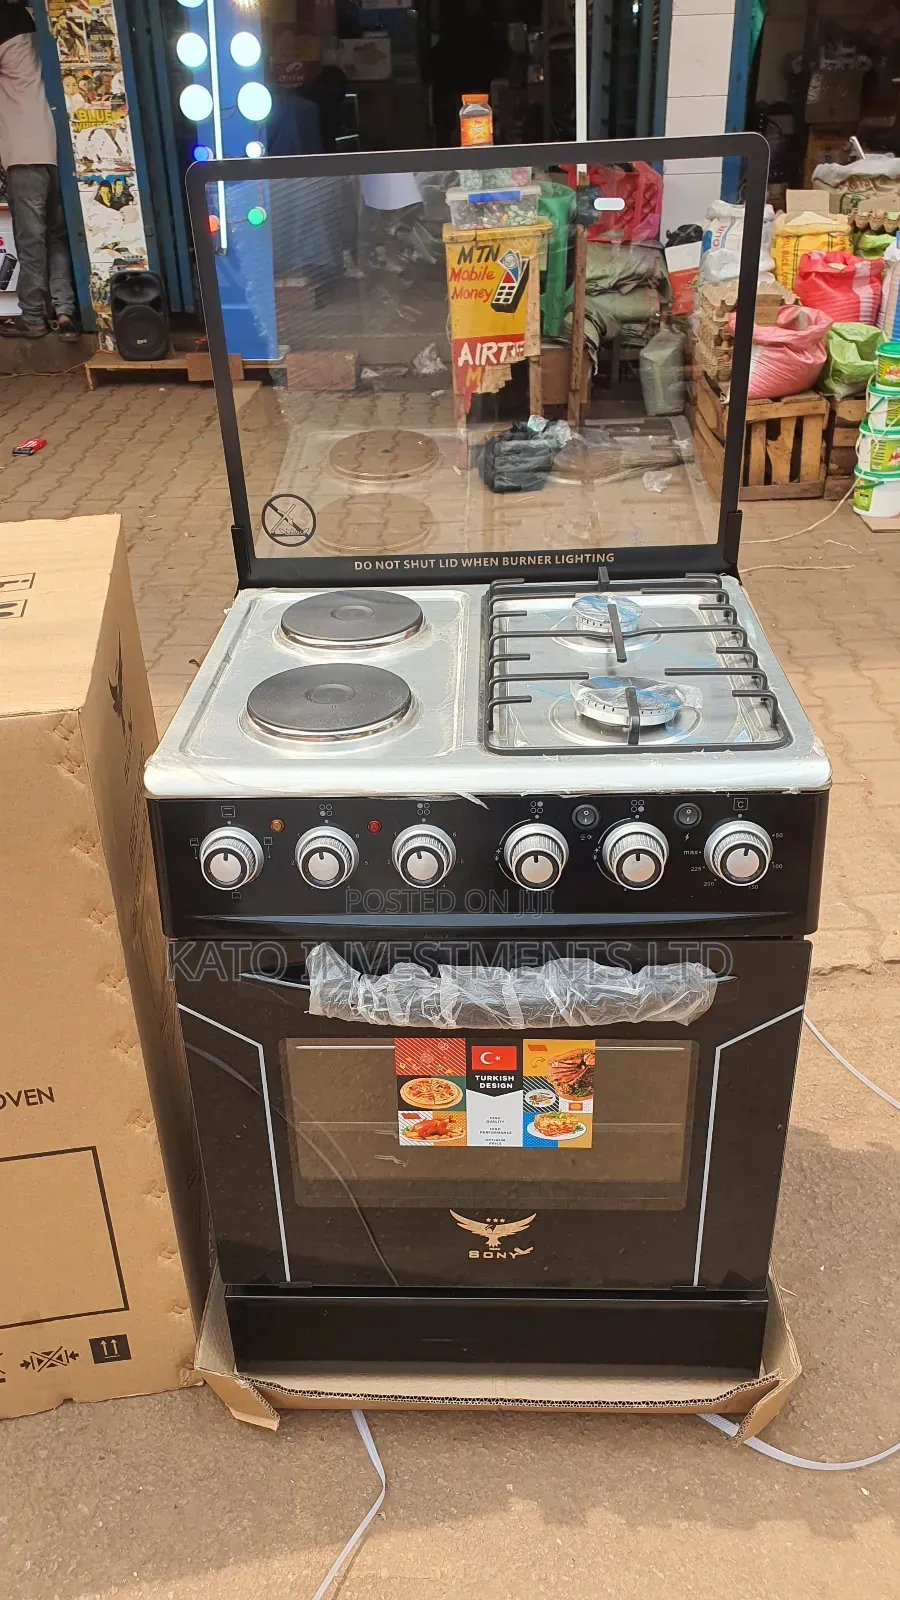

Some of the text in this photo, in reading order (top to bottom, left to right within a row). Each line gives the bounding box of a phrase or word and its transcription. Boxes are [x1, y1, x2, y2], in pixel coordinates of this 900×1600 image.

[457, 244, 501, 266] MTN
[450, 265, 495, 283] Mobile
[451, 287, 494, 303] Money
[354, 553, 615, 571] DO NOT SHUT LID WHEN BURNER LIGHTING
[468, 1248, 520, 1259] SONY
